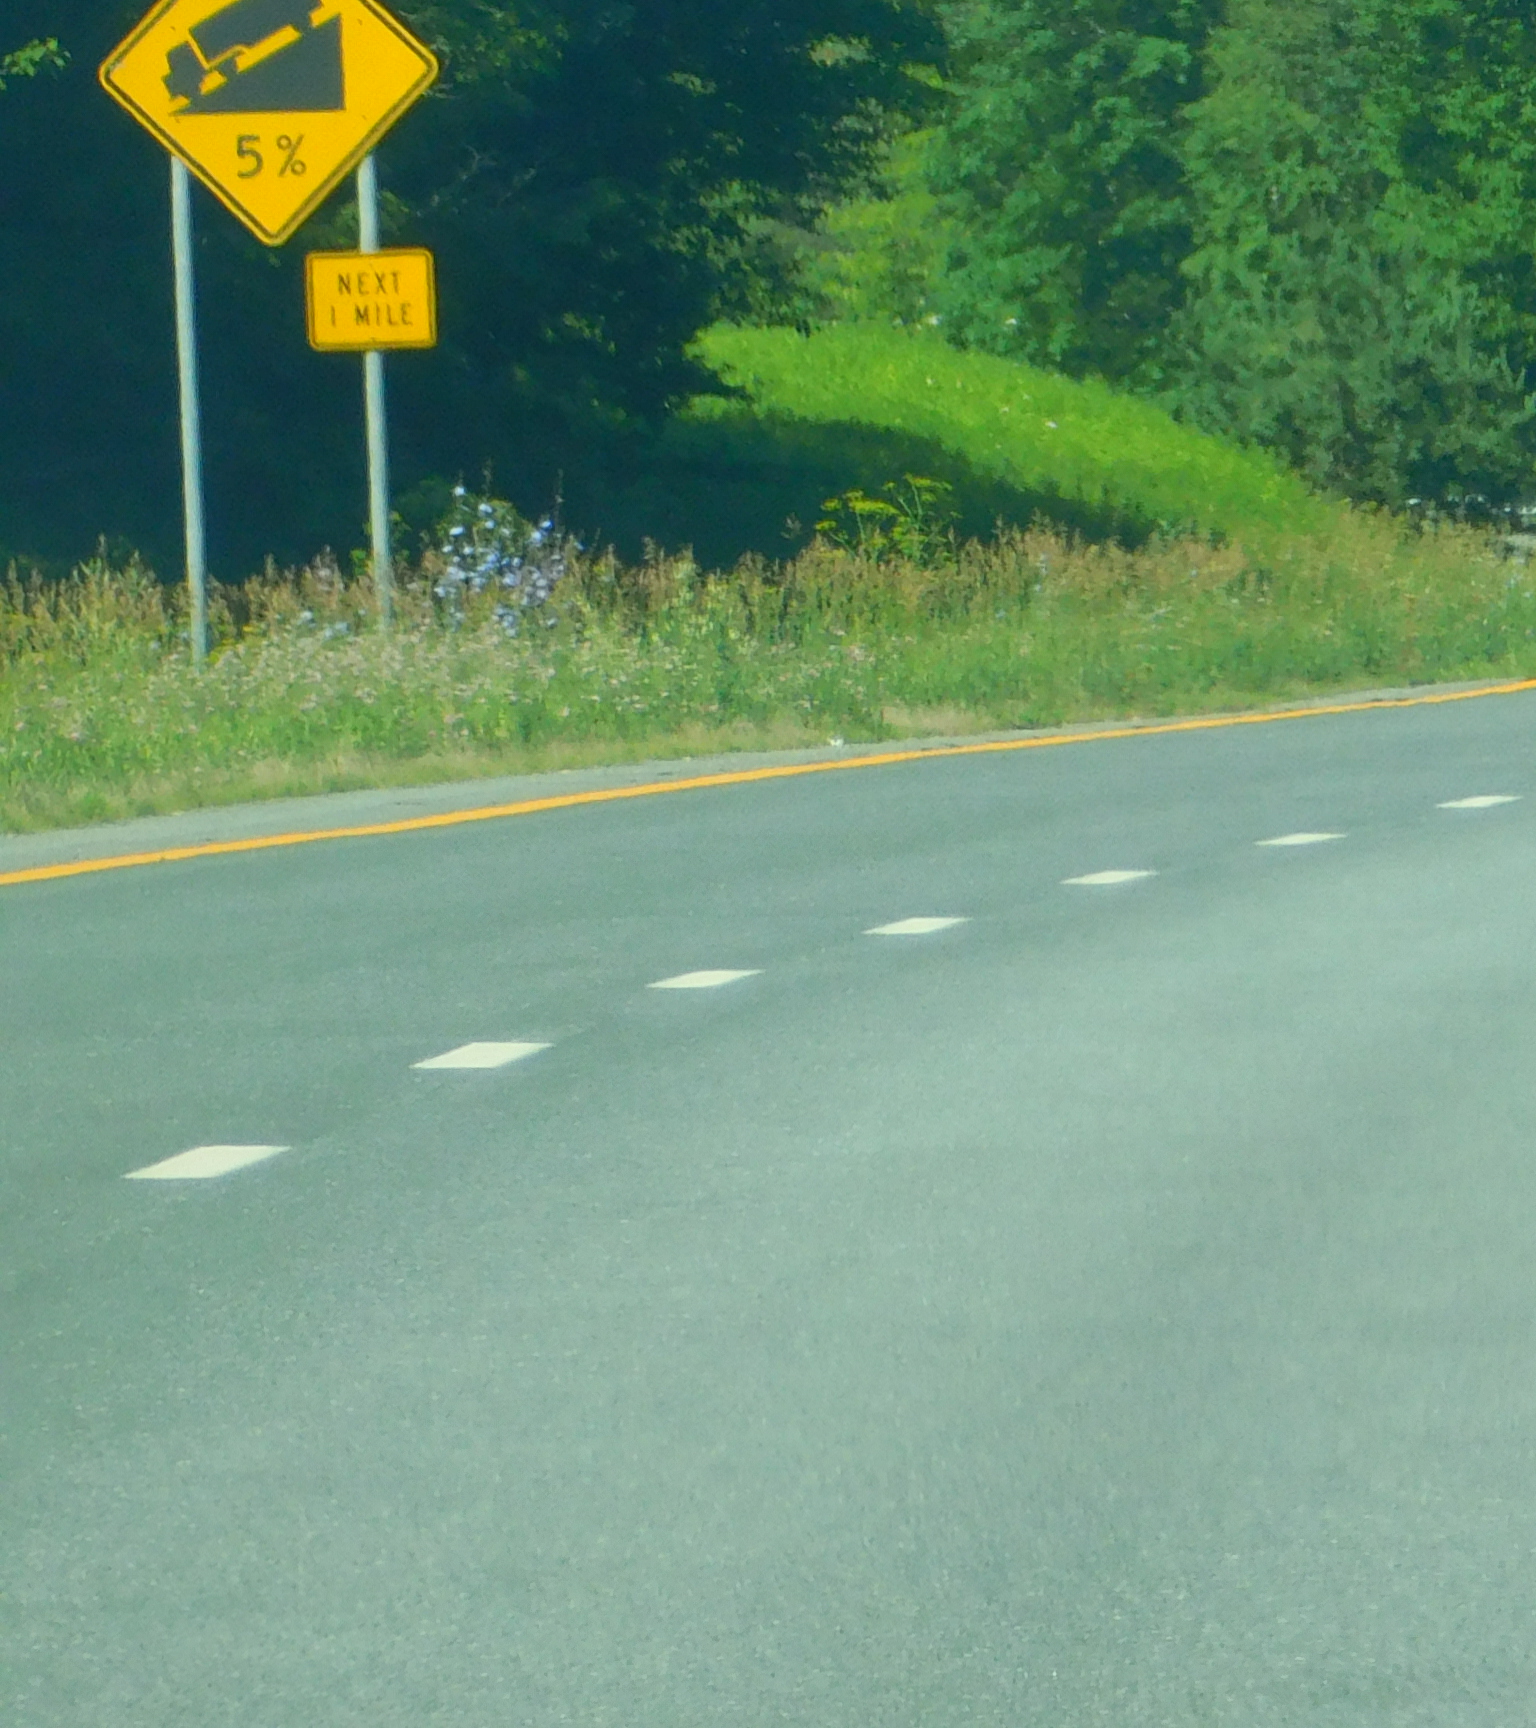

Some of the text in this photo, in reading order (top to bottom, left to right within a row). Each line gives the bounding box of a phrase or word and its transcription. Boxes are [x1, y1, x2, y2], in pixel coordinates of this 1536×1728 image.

[236, 134, 307, 178] 5%
[338, 271, 400, 295] NEXT
[330, 302, 413, 326] 1 MILE
